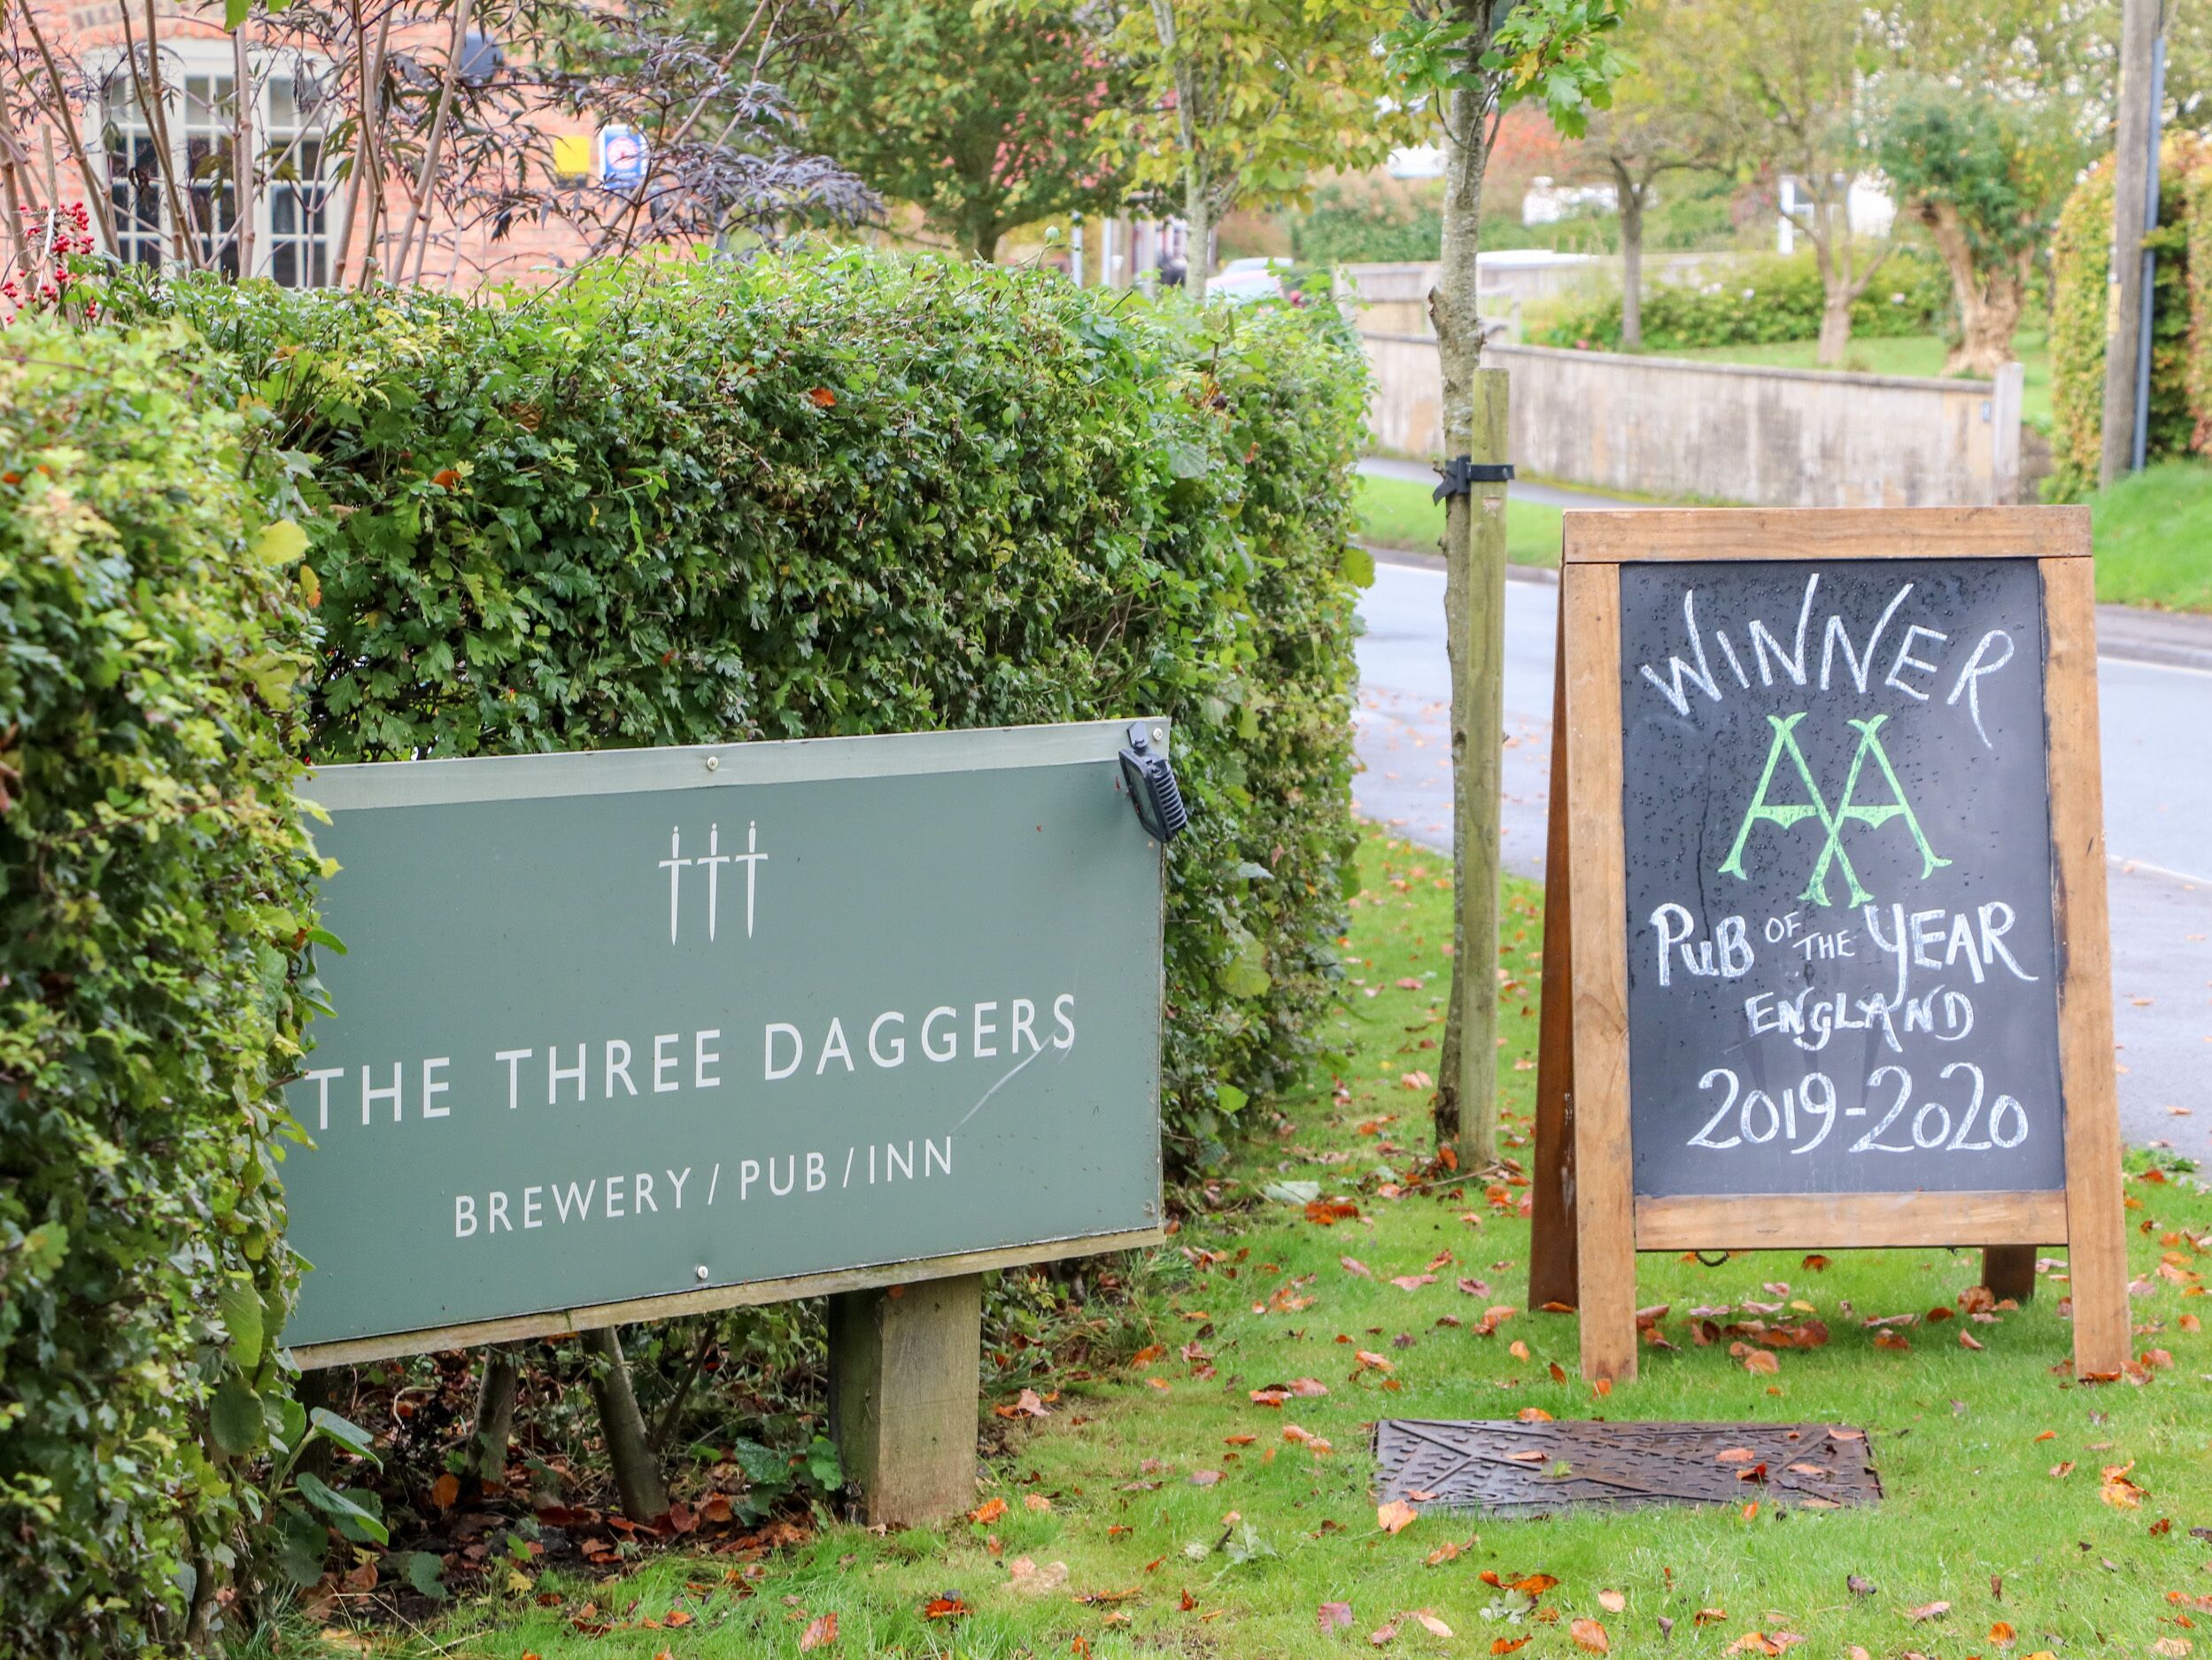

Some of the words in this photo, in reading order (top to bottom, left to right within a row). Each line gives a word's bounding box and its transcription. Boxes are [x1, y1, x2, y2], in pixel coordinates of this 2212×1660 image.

[1640, 573, 2015, 749] WINNER
[1764, 911, 1802, 943] OF
[1792, 930, 1857, 961] THE
[1864, 900, 2039, 1012] YEAR
[304, 1056, 451, 1130] THE
[495, 1029, 721, 1109] THREE
[764, 993, 1075, 1081] DAGGERS
[1686, 1062, 2029, 1154] 2019-2020
[455, 1167, 692, 1238] BREWERY
[740, 1152, 827, 1201] PUB
[869, 1136, 952, 1185] INN
